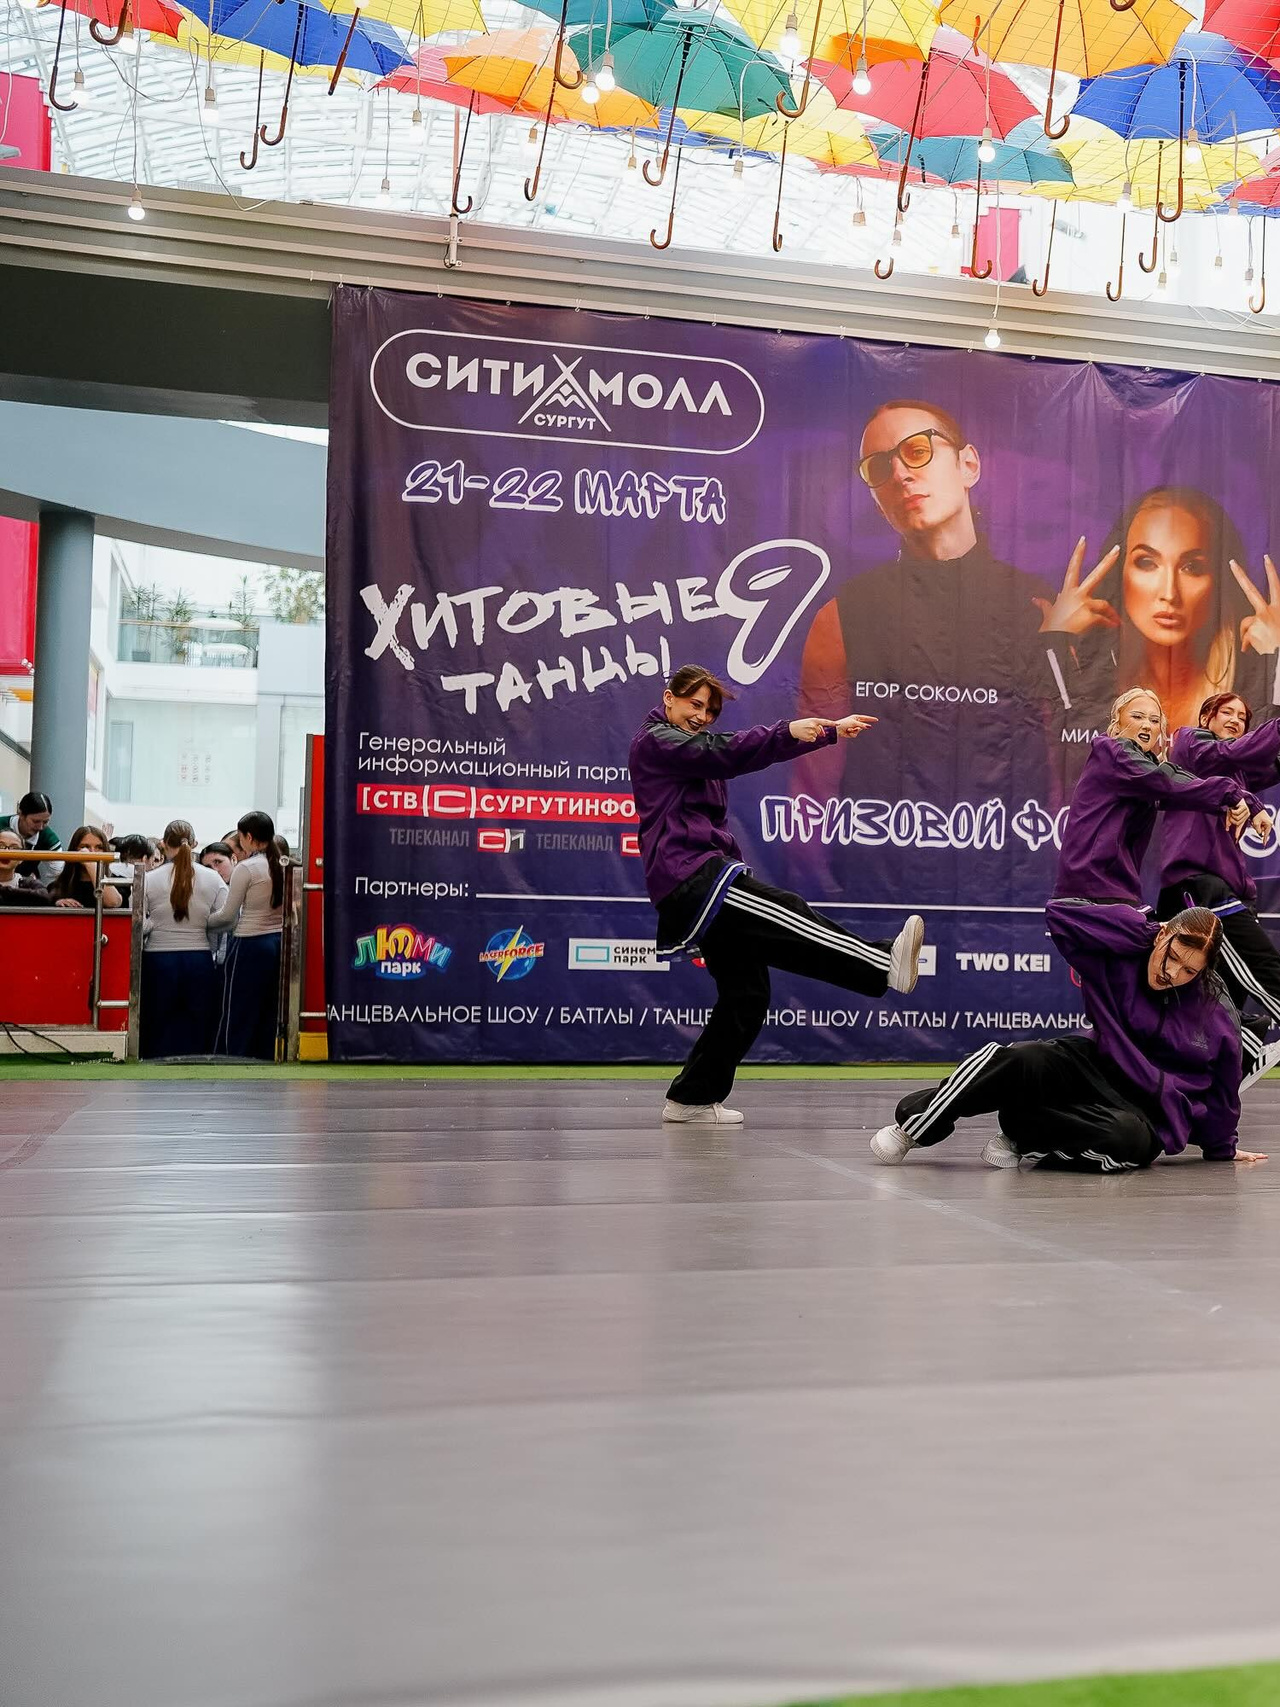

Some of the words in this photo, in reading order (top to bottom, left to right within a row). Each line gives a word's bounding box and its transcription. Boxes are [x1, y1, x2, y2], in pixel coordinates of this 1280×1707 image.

[405, 352, 545, 397] СИТИ
[588, 369, 733, 417] МОЛЛ
[533, 412, 597, 431] СУРГУТ
[401, 460, 564, 513] 21-22
[574, 468, 727, 525] МАРТА
[359, 576, 720, 671] ХИТОВЫЕ
[855, 681, 900, 699] ЕГОР
[904, 684, 999, 704] СОКОЛОВ
[358, 731, 506, 756] Генеральный
[1060, 727, 1100, 744] МИЛ
[358, 754, 571, 779] информационный
[577, 765, 632, 784] парт
[479, 793, 638, 818] СУРГУТИНФО
[759, 793, 1006, 851] ПРИЗОВОЙ
[389, 828, 470, 848] ТЕЛЕКАНАЛ
[536, 832, 614, 852] ТЕЛЕКАНАЛ
[355, 876, 470, 899] Партнеры:
[613, 946, 657, 955] синем
[614, 955, 648, 967] парк
[955, 952, 1009, 972] TWO
[1014, 953, 1051, 972] KEI
[380, 960, 422, 977] парк
[326, 1003, 482, 1025] АНЦЕВАЛЬНОЕ
[487, 1005, 540, 1025] ШОУ
[559, 1006, 634, 1025] БАТТЛЫ
[811, 1009, 860, 1028] ШОУ
[878, 1009, 947, 1028] БАТТЛЫ
[964, 1010, 1094, 1030] ТАНЦЕВАЛЬНО
